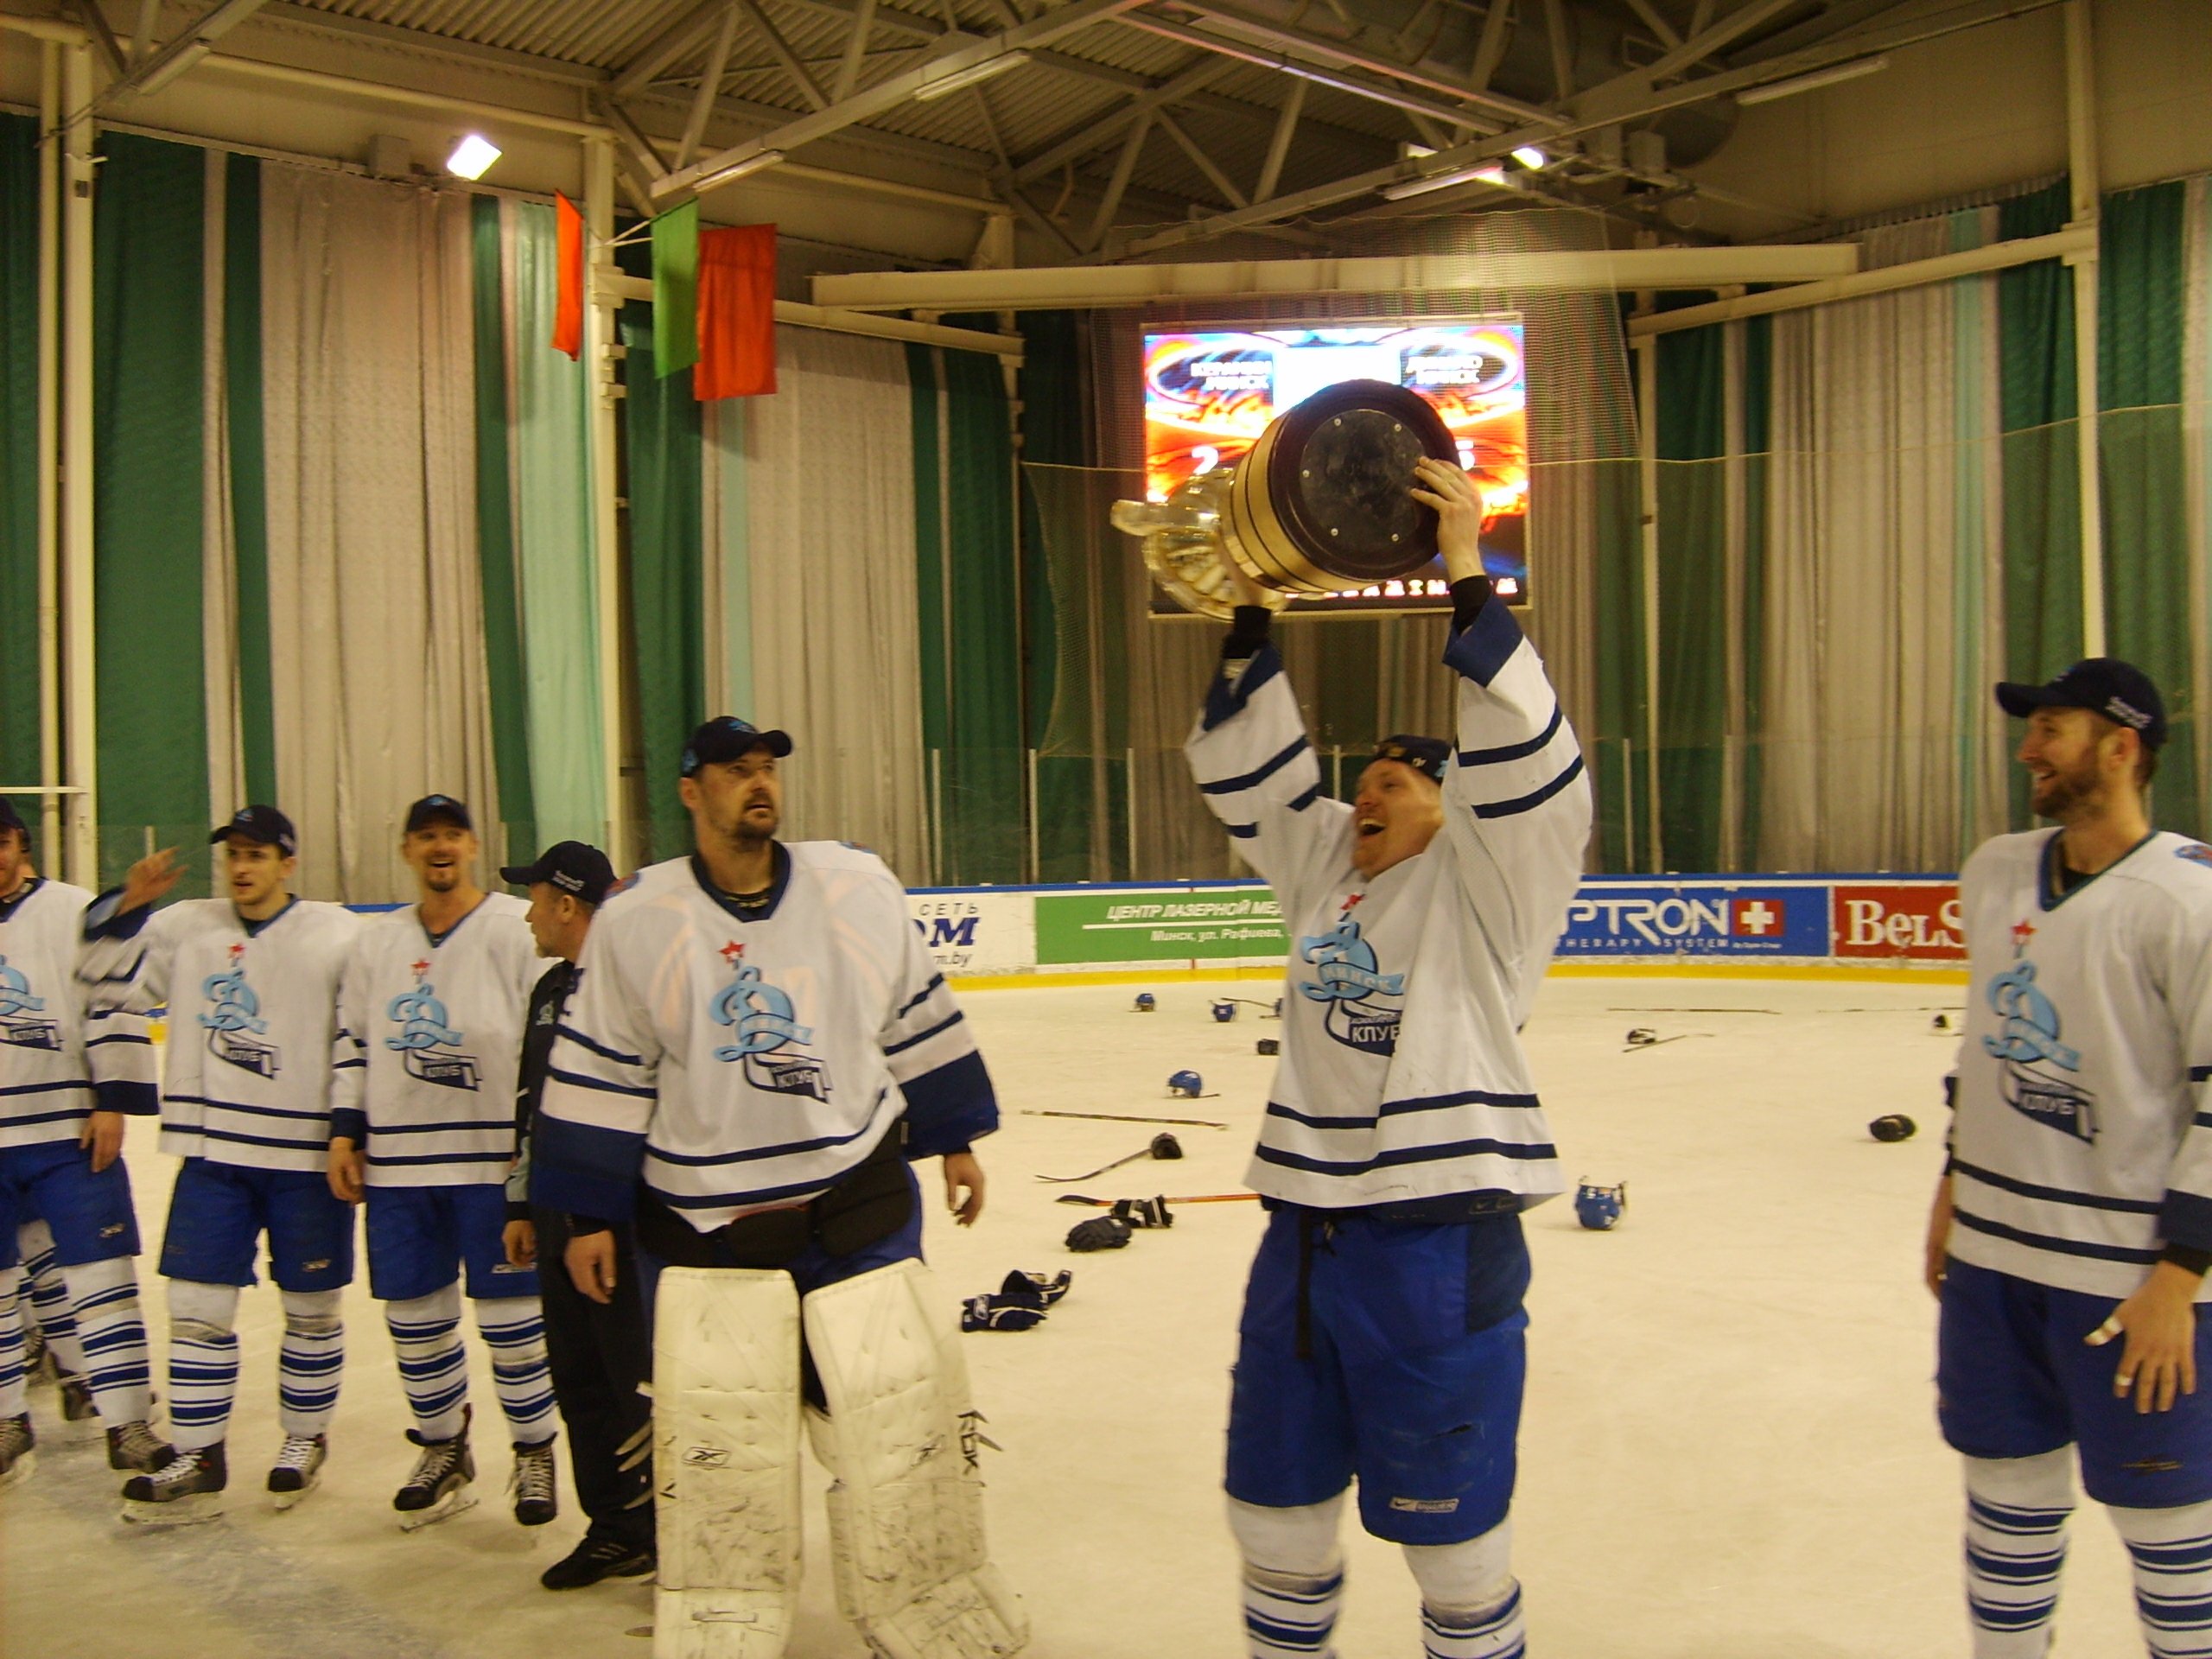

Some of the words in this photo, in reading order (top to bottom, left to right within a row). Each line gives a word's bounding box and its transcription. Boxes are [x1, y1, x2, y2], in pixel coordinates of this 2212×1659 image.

[918, 902, 980, 916] СЕТЬ
[1106, 905, 1164, 922] ЦЕНТР
[1161, 899, 1252, 918] ЛАЗЕРНОЙ
[1663, 938, 1728, 948] SYSTEM
